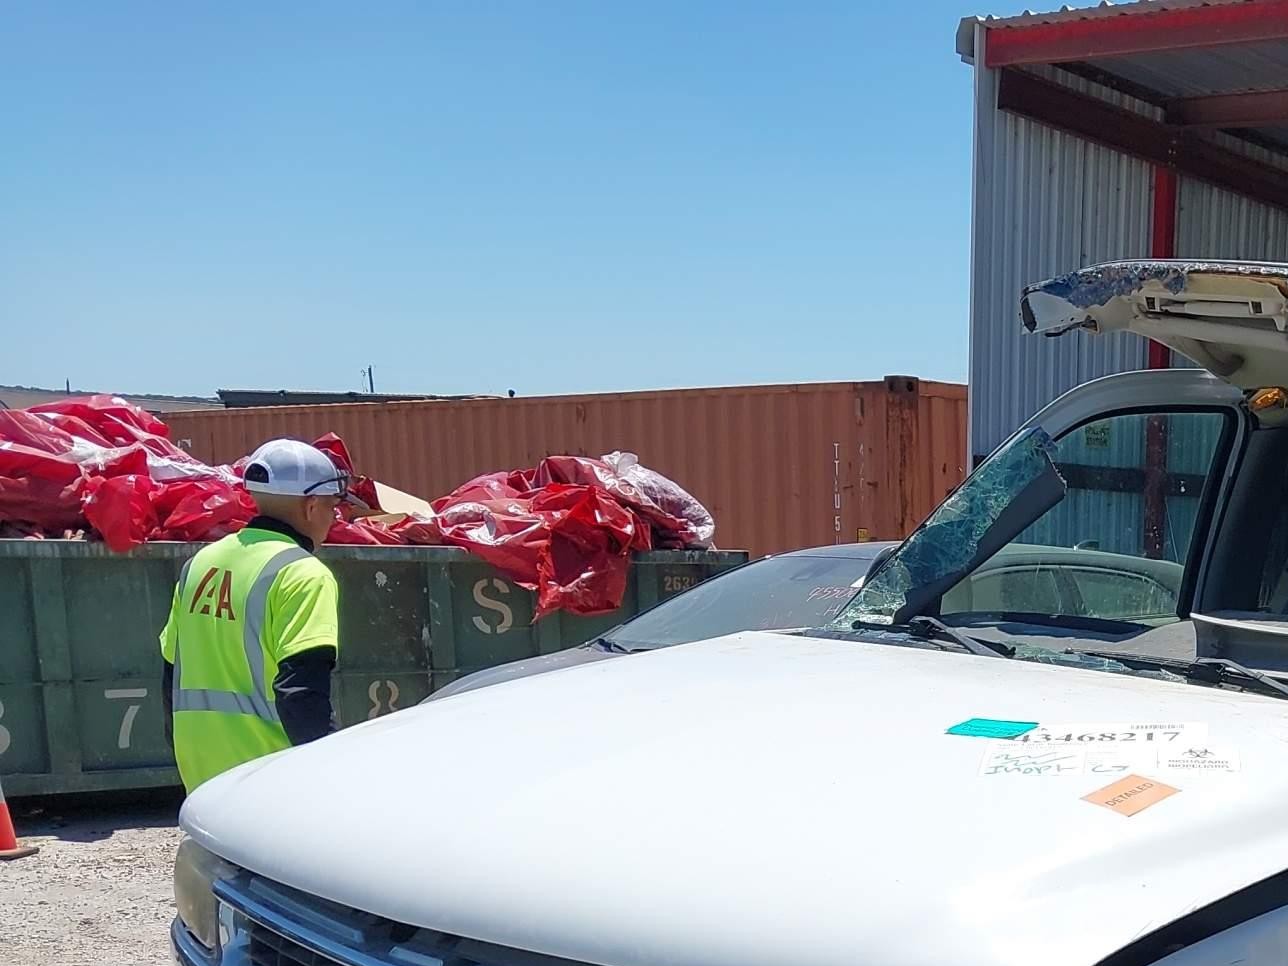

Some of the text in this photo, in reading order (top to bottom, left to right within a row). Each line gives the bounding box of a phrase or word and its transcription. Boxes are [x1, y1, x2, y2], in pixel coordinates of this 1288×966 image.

[472, 578, 513, 634] S
[104, 688, 147, 750] 7
[1014, 731, 1181, 743] 43468217
[1104, 782, 1155, 807] DETAILED
